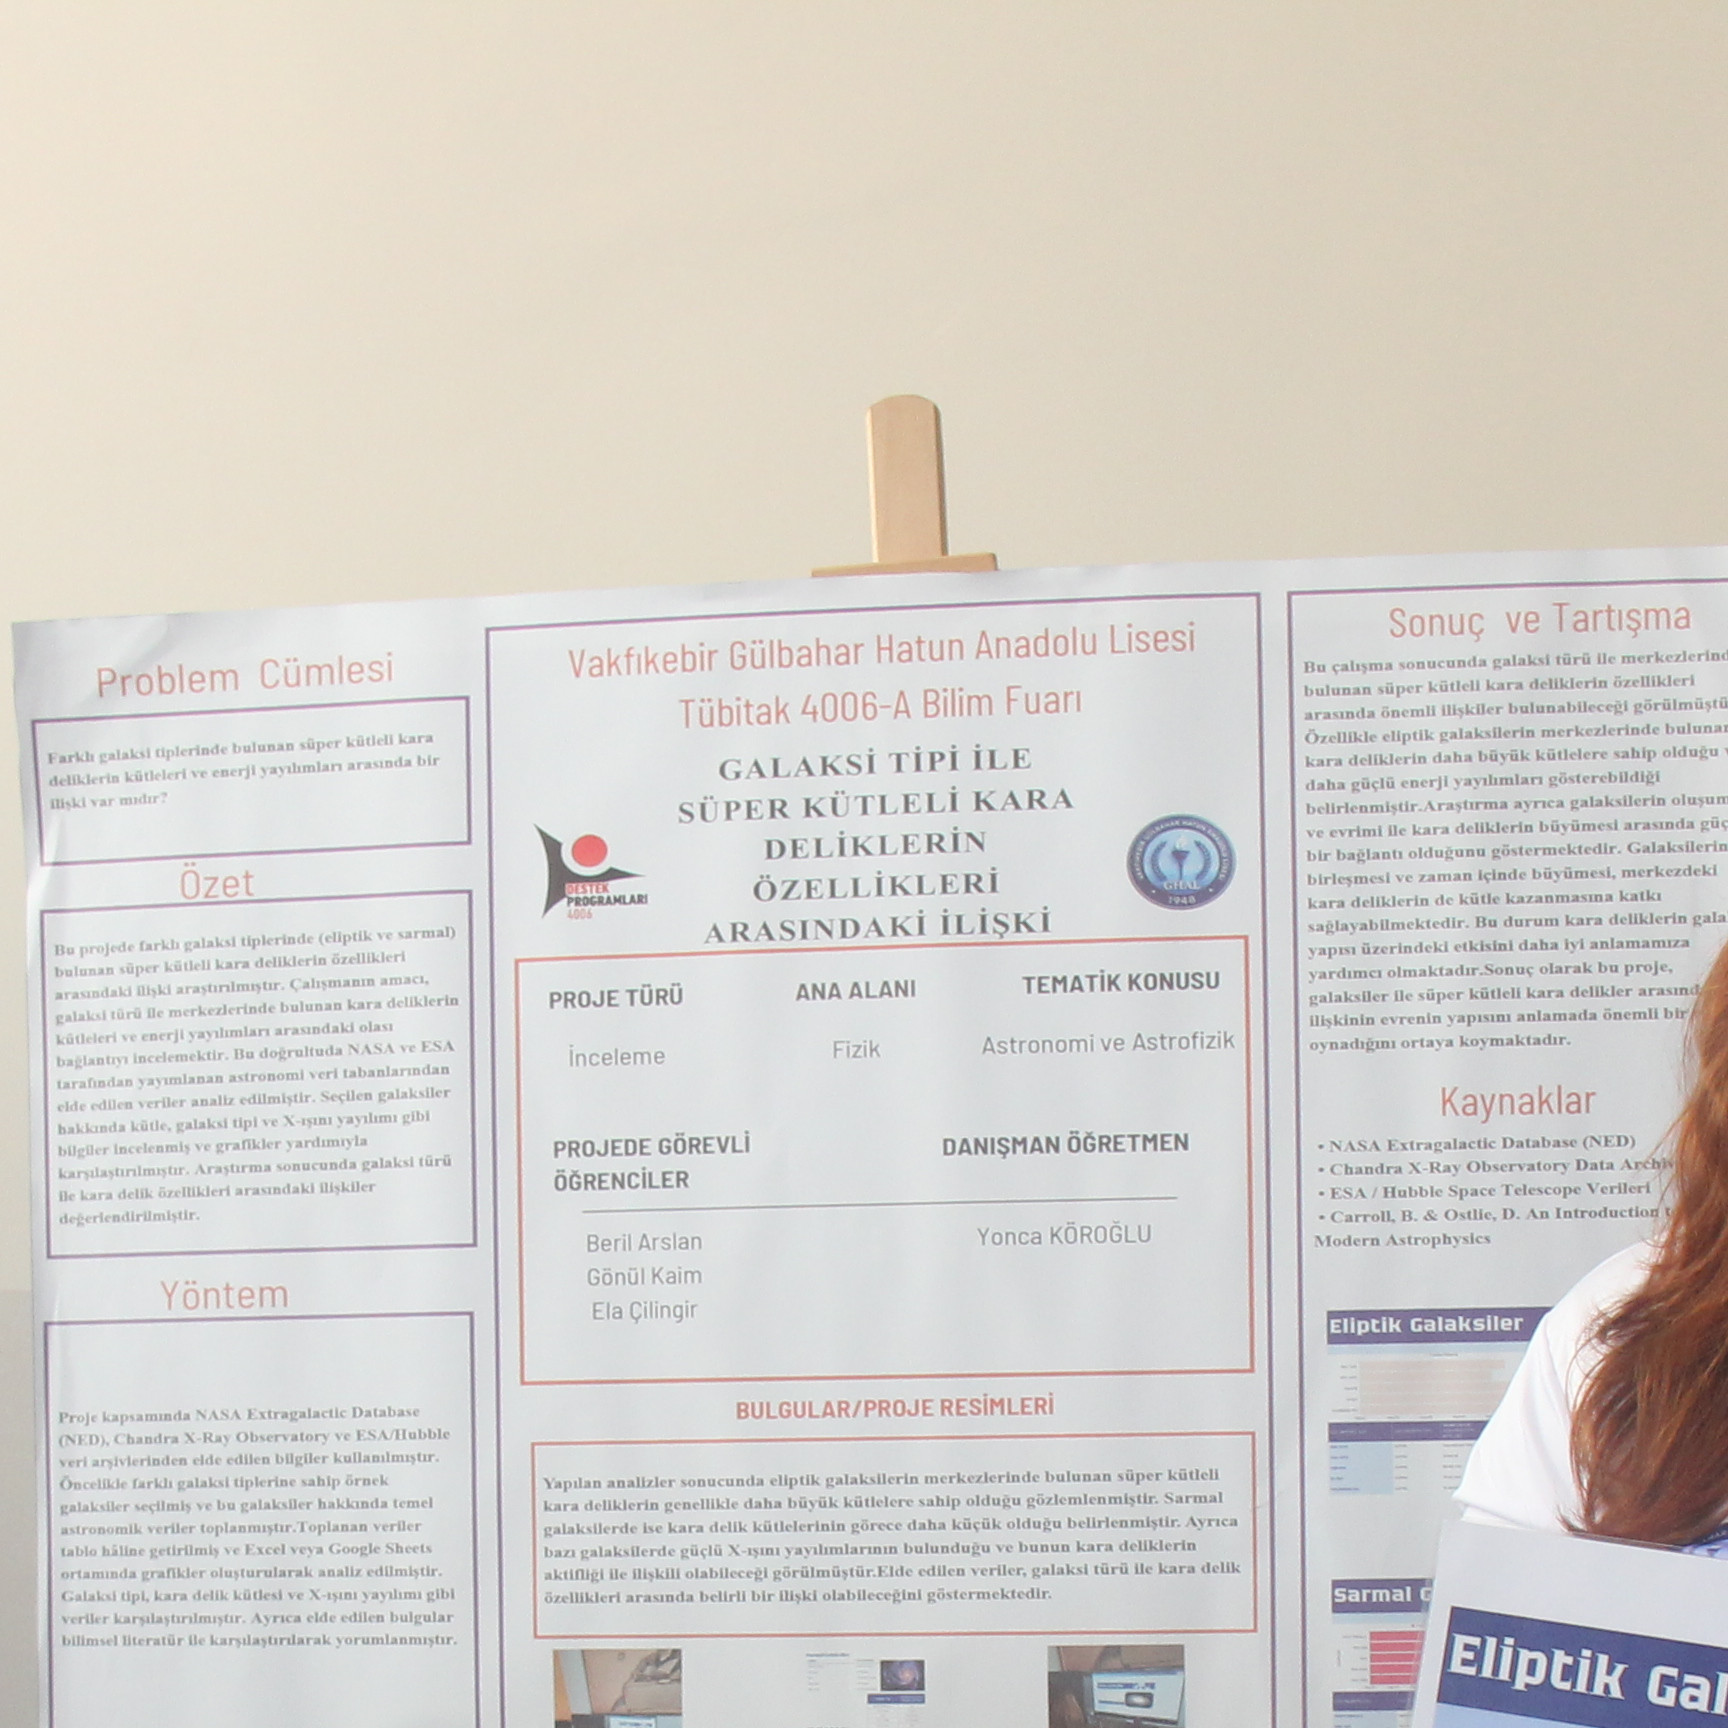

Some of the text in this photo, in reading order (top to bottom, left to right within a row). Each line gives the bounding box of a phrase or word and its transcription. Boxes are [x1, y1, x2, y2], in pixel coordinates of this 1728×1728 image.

[1390, 603, 1690, 642] Sonuç ve Tartışma
[569, 621, 1194, 678] Vakfıkebir Gülbahar Hatun Anadolu Lisesi
[98, 652, 392, 698] Problem Cümlesi
[679, 686, 1080, 728] Tübitak 4006-A Bilim Fuarı
[100, 748, 150, 764] galaksi
[156, 744, 227, 761] tiplerinde
[233, 742, 294, 753] bulunan
[300, 738, 341, 753] süper
[346, 735, 393, 747] kütleli
[399, 734, 433, 744] kara
[719, 744, 1030, 780] GALAKSİ TİPİ İLE
[678, 786, 1072, 823] SÜPER KÜTLELİ KARA
[766, 827, 984, 859] DELİKLERİN
[181, 862, 254, 899] Özet
[566, 882, 610, 895] DESTEK
[754, 867, 997, 901] ÖZELLİKLERİ
[567, 893, 648, 907] PROGRAMLARI
[567, 908, 592, 919] 4006
[704, 908, 1049, 945] ARASINDAKİ İLİŞKİ
[796, 980, 915, 1000] ANA ALANI
[1023, 970, 1219, 994] TEMATİK KONUSU
[550, 983, 682, 1009] PROJE TÜRÜ
[834, 1040, 880, 1058] Fizik
[983, 1031, 1235, 1054] Astronomi ve Astrofizik
[570, 1045, 665, 1066] İnceleme
[1442, 1085, 1596, 1124] Kaynaklar
[554, 1131, 749, 1158] PROJEDE GÖREVLİ
[943, 1131, 1188, 1159] DANIŞMAN ÖĞRETMEN
[1330, 1135, 1635, 1153] NASA Extragalactic Database (NED)
[555, 1167, 689, 1191] ÖĞRENCİLER
[1330, 1159, 1614, 1175] Chandra X-Ray Observatory Data
[1331, 1182, 1650, 1200] ESA / Hubble Space Telescope Verileri
[587, 1233, 702, 1252] Beril Arslan
[977, 1221, 1151, 1245] Yonca KÖROĞLU
[1315, 1233, 1490, 1249] Modern Astrophysics
[588, 1267, 701, 1286] Gönül Kaim
[161, 1281, 287, 1310] Yöntem
[593, 1300, 698, 1324] Ela Çilingir
[1330, 1313, 1524, 1336] Eliptik Galaksiler
[737, 1392, 1053, 1419] BULGULAR/PROJE RESİMLERİ
[1333, 1585, 1412, 1604] Sarmal
[1447, 1631, 1628, 1699] Eliptik
